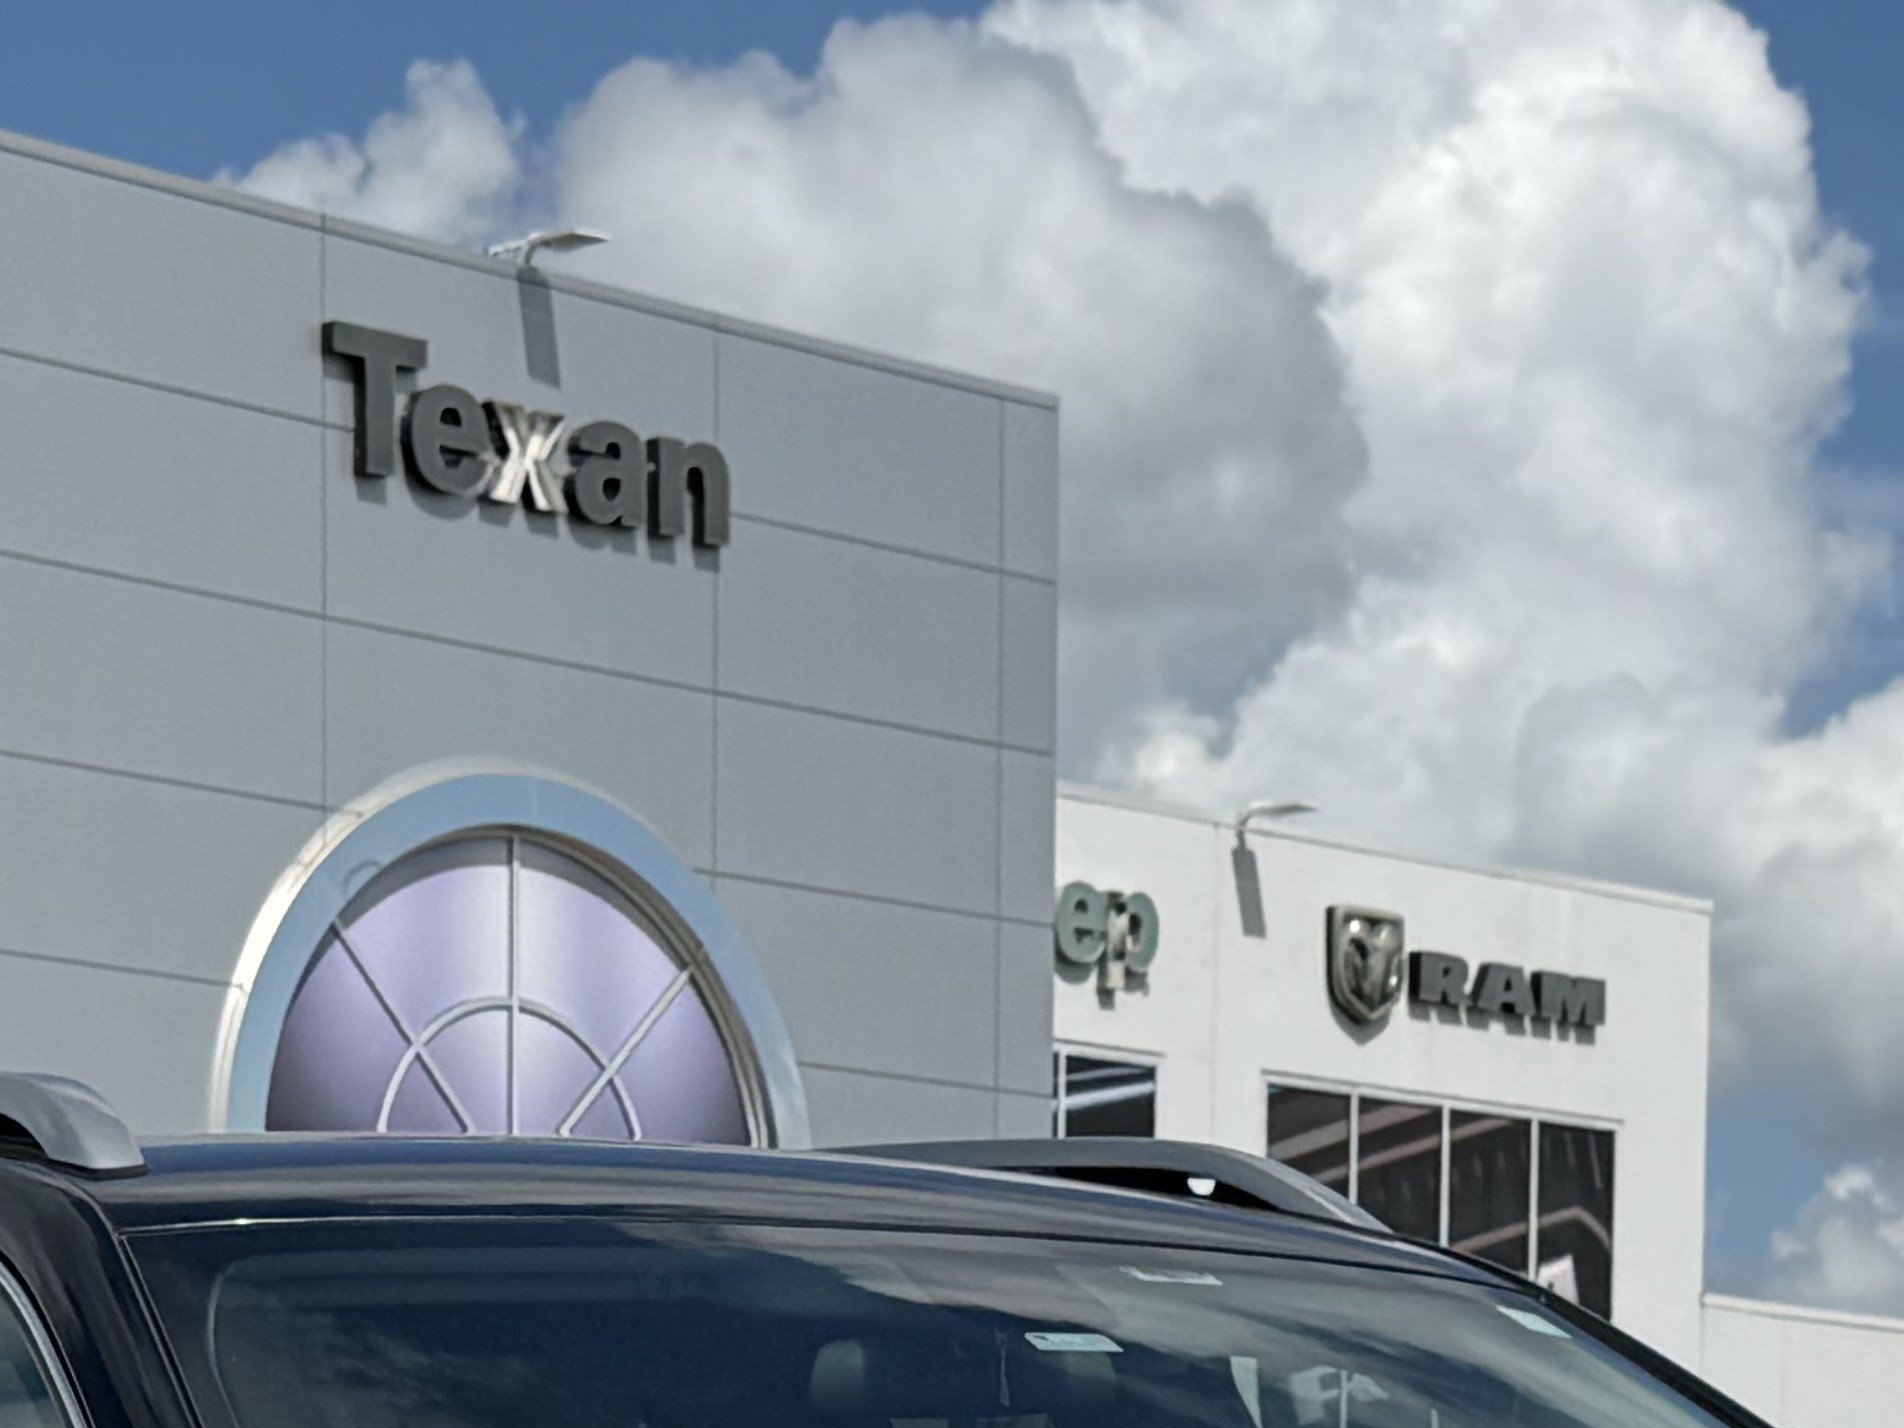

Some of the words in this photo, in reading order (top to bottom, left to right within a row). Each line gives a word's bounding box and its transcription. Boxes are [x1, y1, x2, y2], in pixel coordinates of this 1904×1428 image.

[322, 320, 730, 548] Texan
[1055, 881, 1160, 989] ep
[1408, 950, 1606, 1025] RAM
